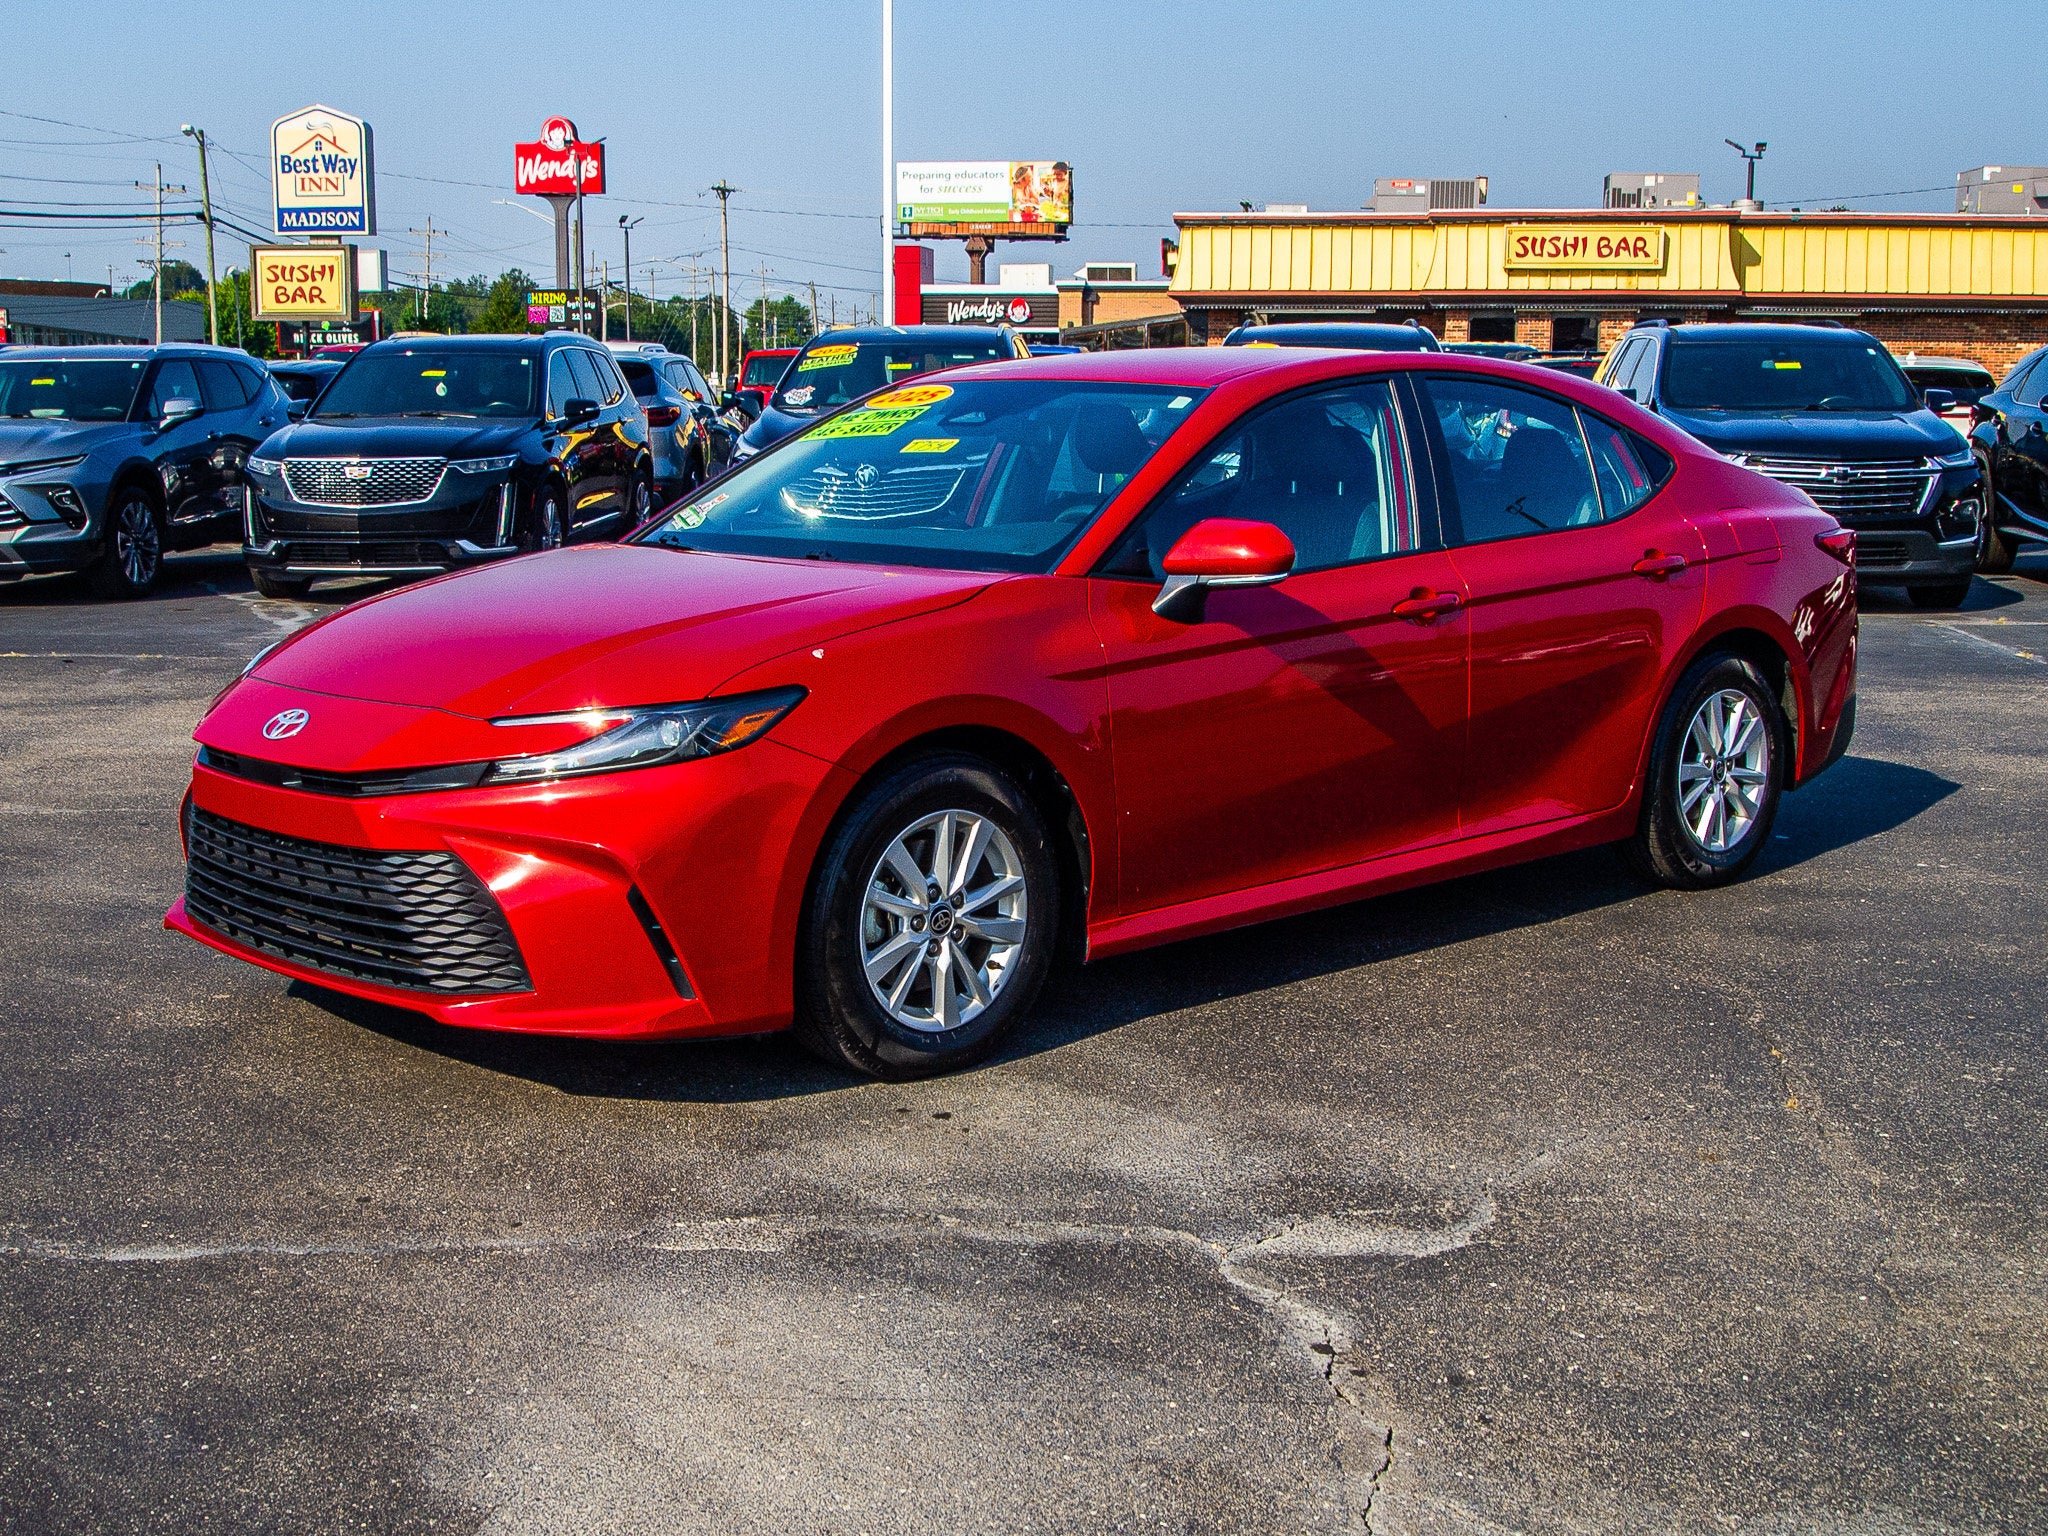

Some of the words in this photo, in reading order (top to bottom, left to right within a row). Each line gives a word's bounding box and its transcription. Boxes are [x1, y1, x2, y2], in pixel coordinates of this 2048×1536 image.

[280, 154, 318, 174] Best
[321, 154, 358, 180] Way
[518, 150, 599, 187] Wendy's
[299, 176, 341, 192] INN
[902, 171, 951, 182] Preparing
[954, 171, 1005, 180] educators
[920, 184, 934, 194] for
[937, 184, 984, 194] success
[282, 211, 360, 228] MADISON
[1515, 236, 1588, 258] SUSHI
[1596, 236, 1651, 258] BAR
[266, 264, 336, 284] SUSHI
[274, 286, 327, 305] BAR
[531, 292, 567, 305] HIRING
[947, 297, 1005, 324] Wendy's
[326, 332, 360, 344] OLIVES
[871, 390, 947, 404] 2025
